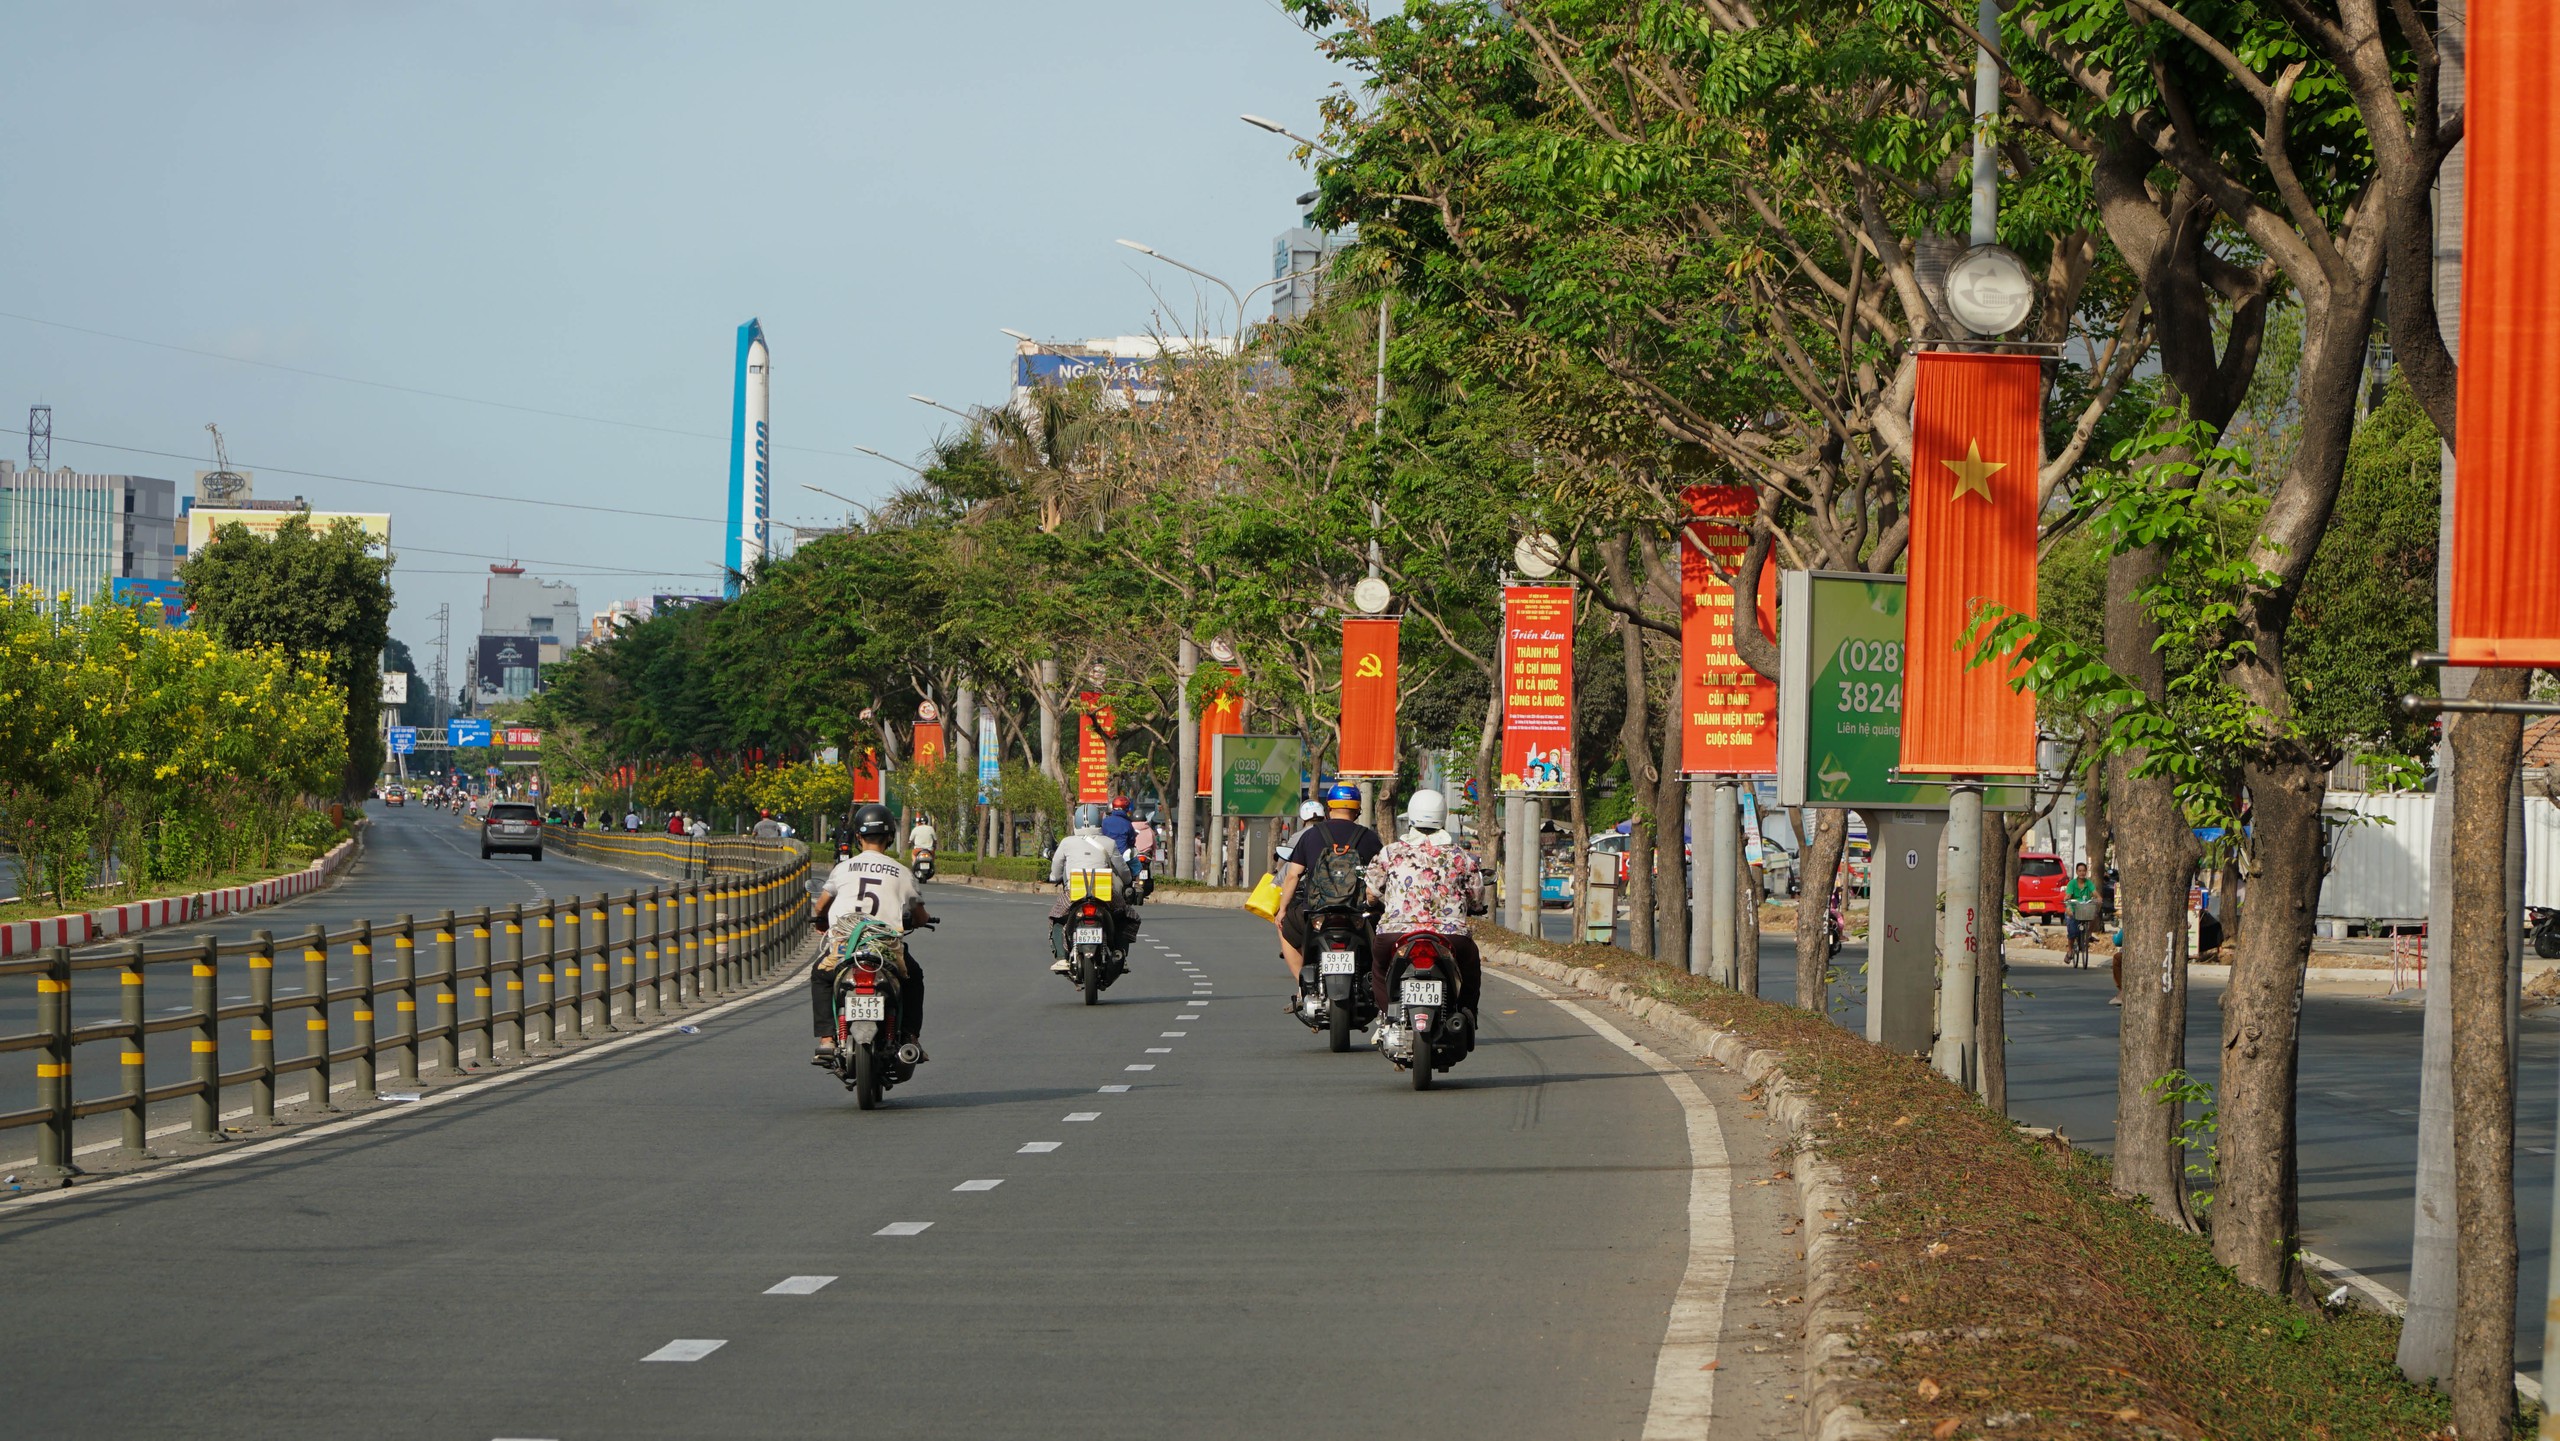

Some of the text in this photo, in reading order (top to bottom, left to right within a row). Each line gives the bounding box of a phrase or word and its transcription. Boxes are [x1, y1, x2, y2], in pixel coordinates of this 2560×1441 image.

[755, 420, 769, 540] SAWACO
[1708, 533, 1749, 547] TOÀN DÂN
[1695, 593, 1734, 609] ĐƯA NGHỊ
[1713, 614, 1728, 629] ĐẠI
[1511, 629, 1565, 641] Triển Lãm
[1711, 634, 1726, 649] ĐẠI
[1517, 644, 1559, 659] THÀNH PHỐ
[1706, 651, 1728, 666] TOÀN
[1514, 660, 1562, 676] HỒ CHÍ MINH
[1516, 676, 1559, 691] VÌ CẢ NƯỚC
[1721, 671, 1737, 686] THỨ
[1740, 673, 1757, 686] XIII
[1509, 692, 1565, 707] CÙNG CẢ NƯỚC
[1708, 690, 1750, 706] CỦA ĐẢNG
[1693, 711, 1765, 728] THÀNH HIỆN THỰC
[1706, 729, 1753, 748] CUỘC SỐNG
[1837, 722, 1900, 740] Liên hệ quảng
[1234, 760, 1260, 773] (028)
[1234, 774, 1280, 786] 3824.1919
[1908, 854, 1916, 865] 11
[848, 862, 900, 878] MINT COFFEE
[855, 877, 883, 917] 5
[1326, 953, 1350, 963] 59-P2
[1410, 982, 1435, 993] 59-P1
[1406, 993, 1440, 1004] 214.38
[851, 1008, 879, 1019] 8593
